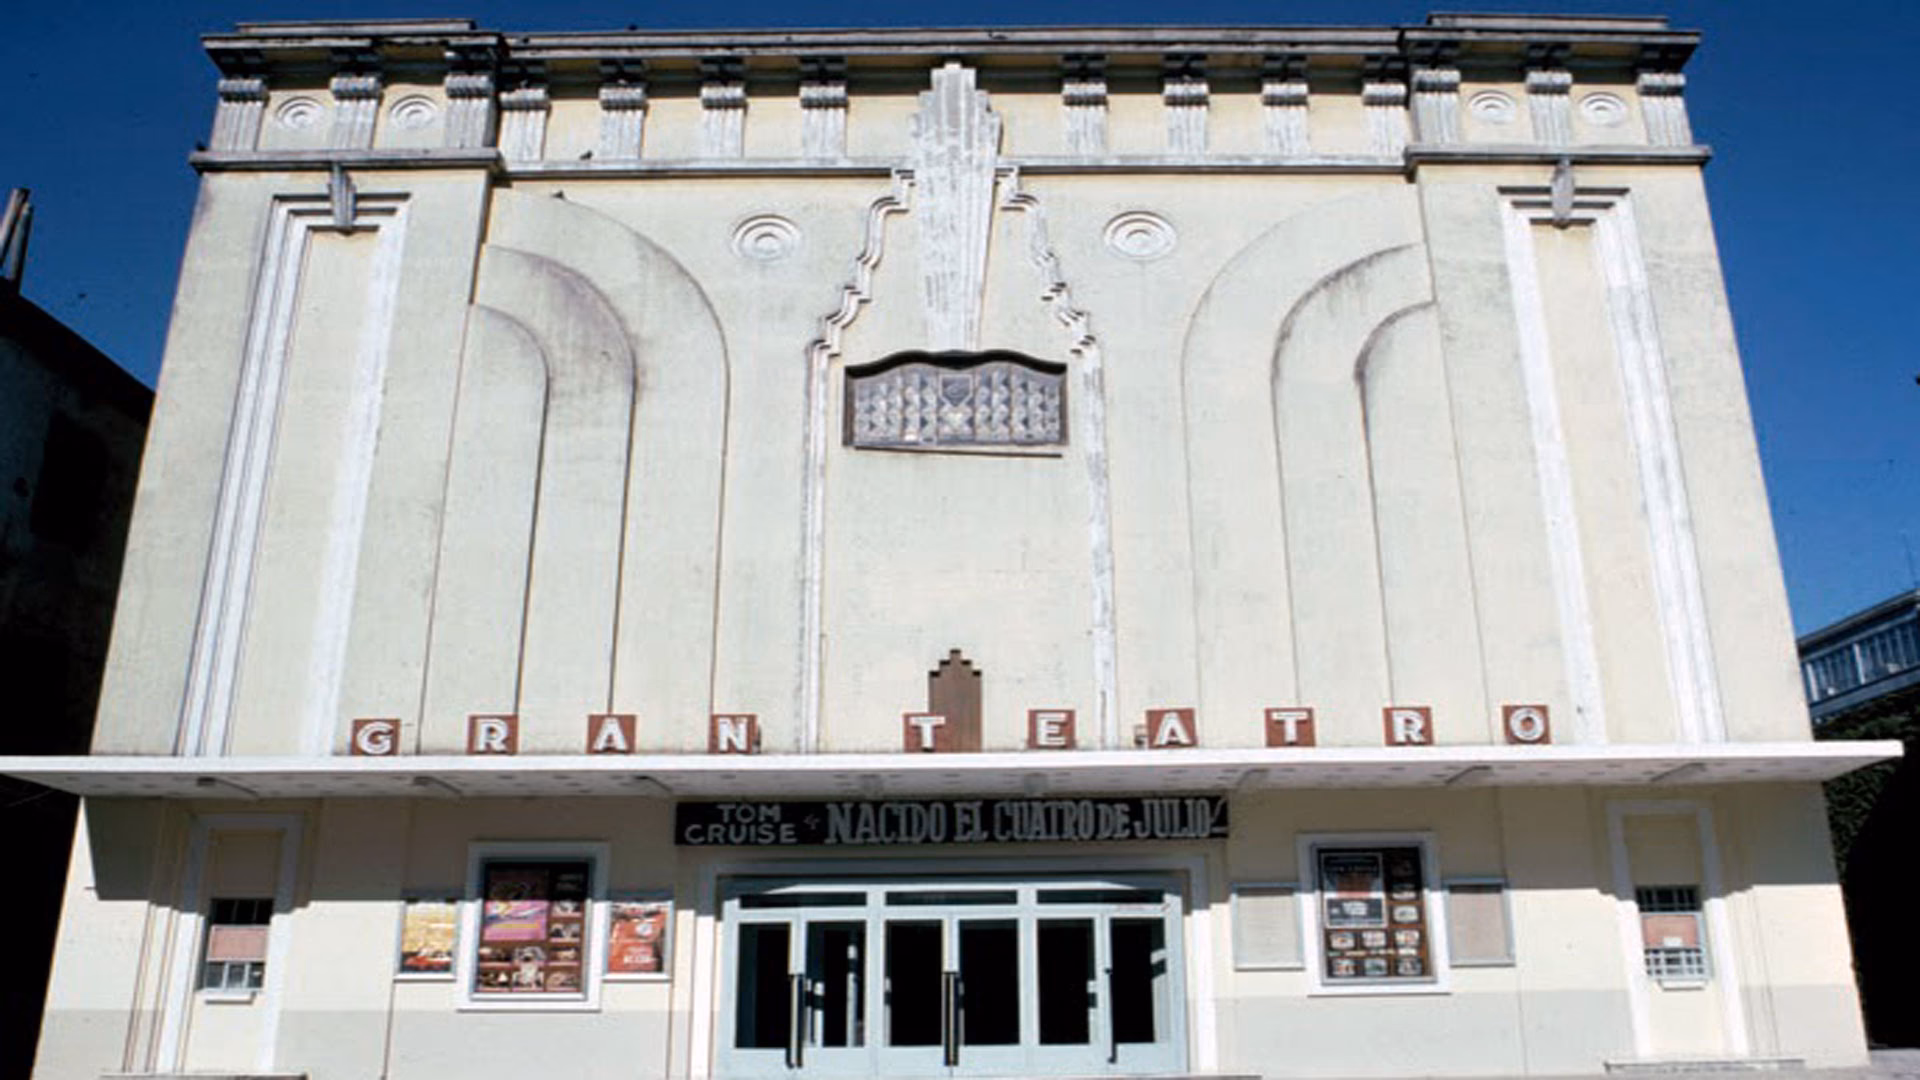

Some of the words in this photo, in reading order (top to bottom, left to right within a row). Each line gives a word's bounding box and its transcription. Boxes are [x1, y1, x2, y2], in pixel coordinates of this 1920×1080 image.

[355, 716, 754, 754] GRAN
[907, 708, 1548, 752] TEATRO
[716, 803, 781, 824] TOM
[824, 801, 948, 844] NACIDO
[953, 801, 988, 842] EL
[992, 799, 1096, 841] CUATRO
[1096, 801, 1131, 839] DE
[684, 823, 798, 844] CRUISE
